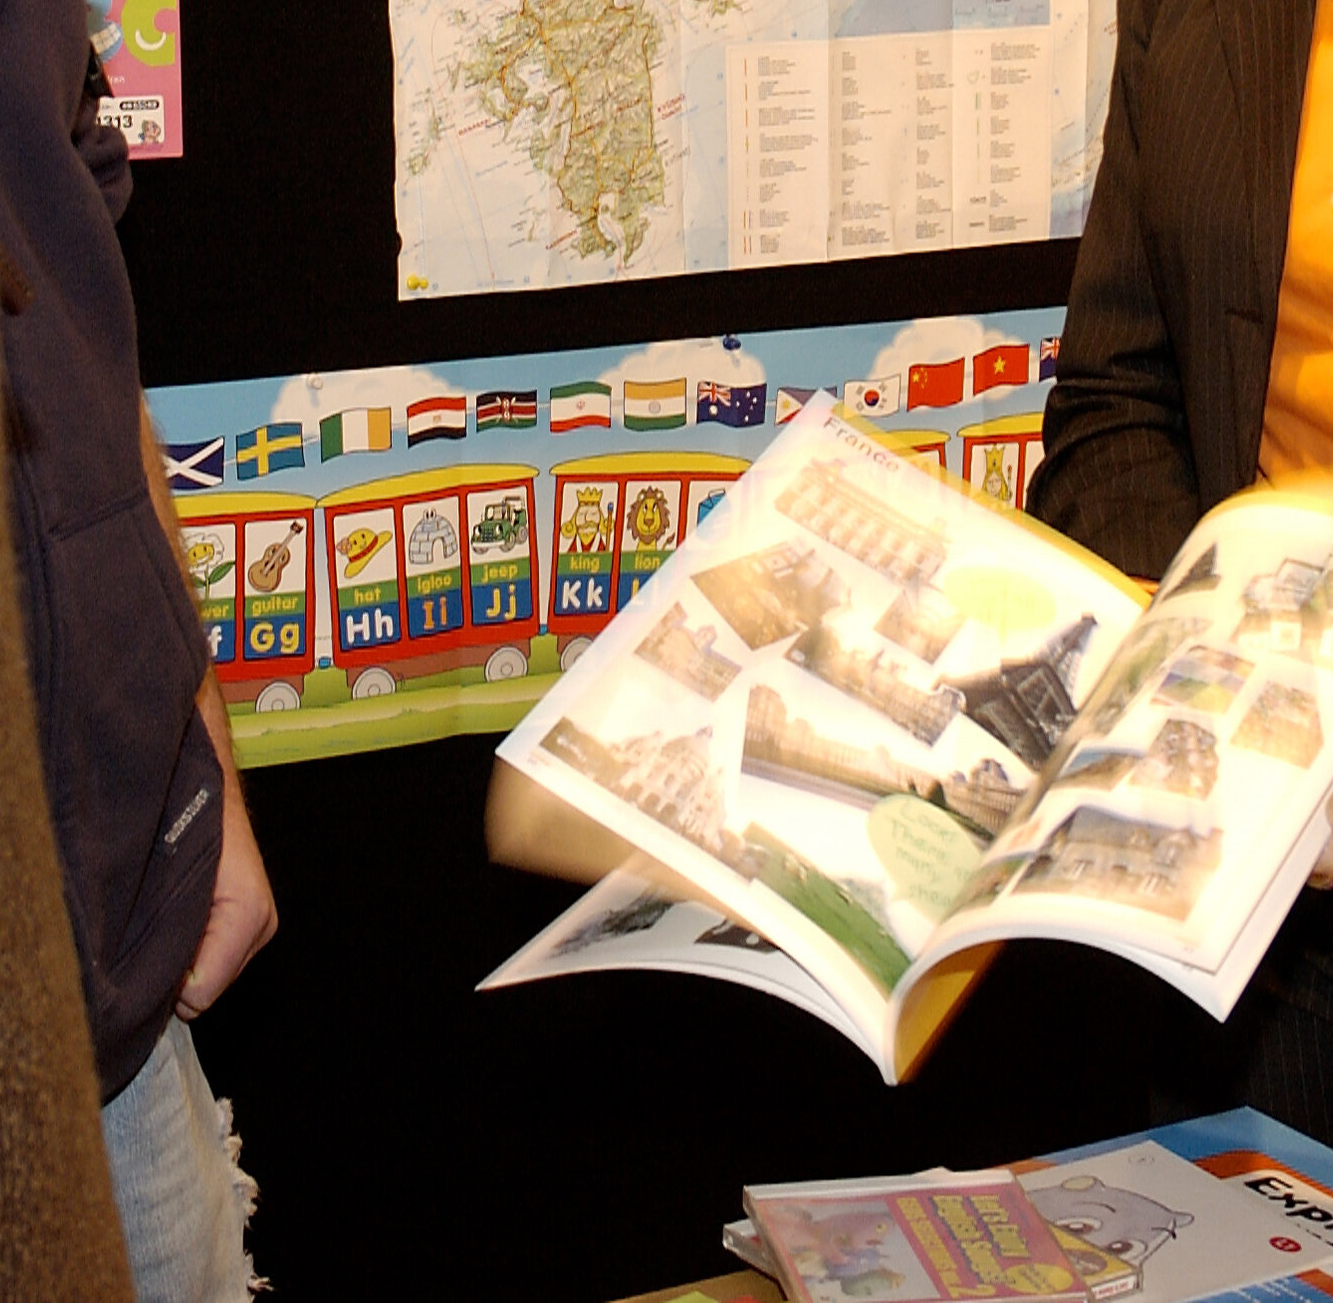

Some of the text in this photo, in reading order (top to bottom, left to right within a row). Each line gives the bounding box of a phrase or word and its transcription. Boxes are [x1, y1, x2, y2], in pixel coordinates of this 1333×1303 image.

[482, 563, 519, 583] jeep
[570, 555, 600, 573] king
[634, 555, 661, 570] lion
[417, 573, 452, 594] igloo
[562, 578, 603, 610] Kk
[251, 595, 298, 617] guitar
[353, 588, 381, 603] hat
[485, 584, 517, 620] Jj
[422, 595, 448, 631] Ii
[346, 608, 394, 644] Hh
[249, 622, 300, 653] Gg
